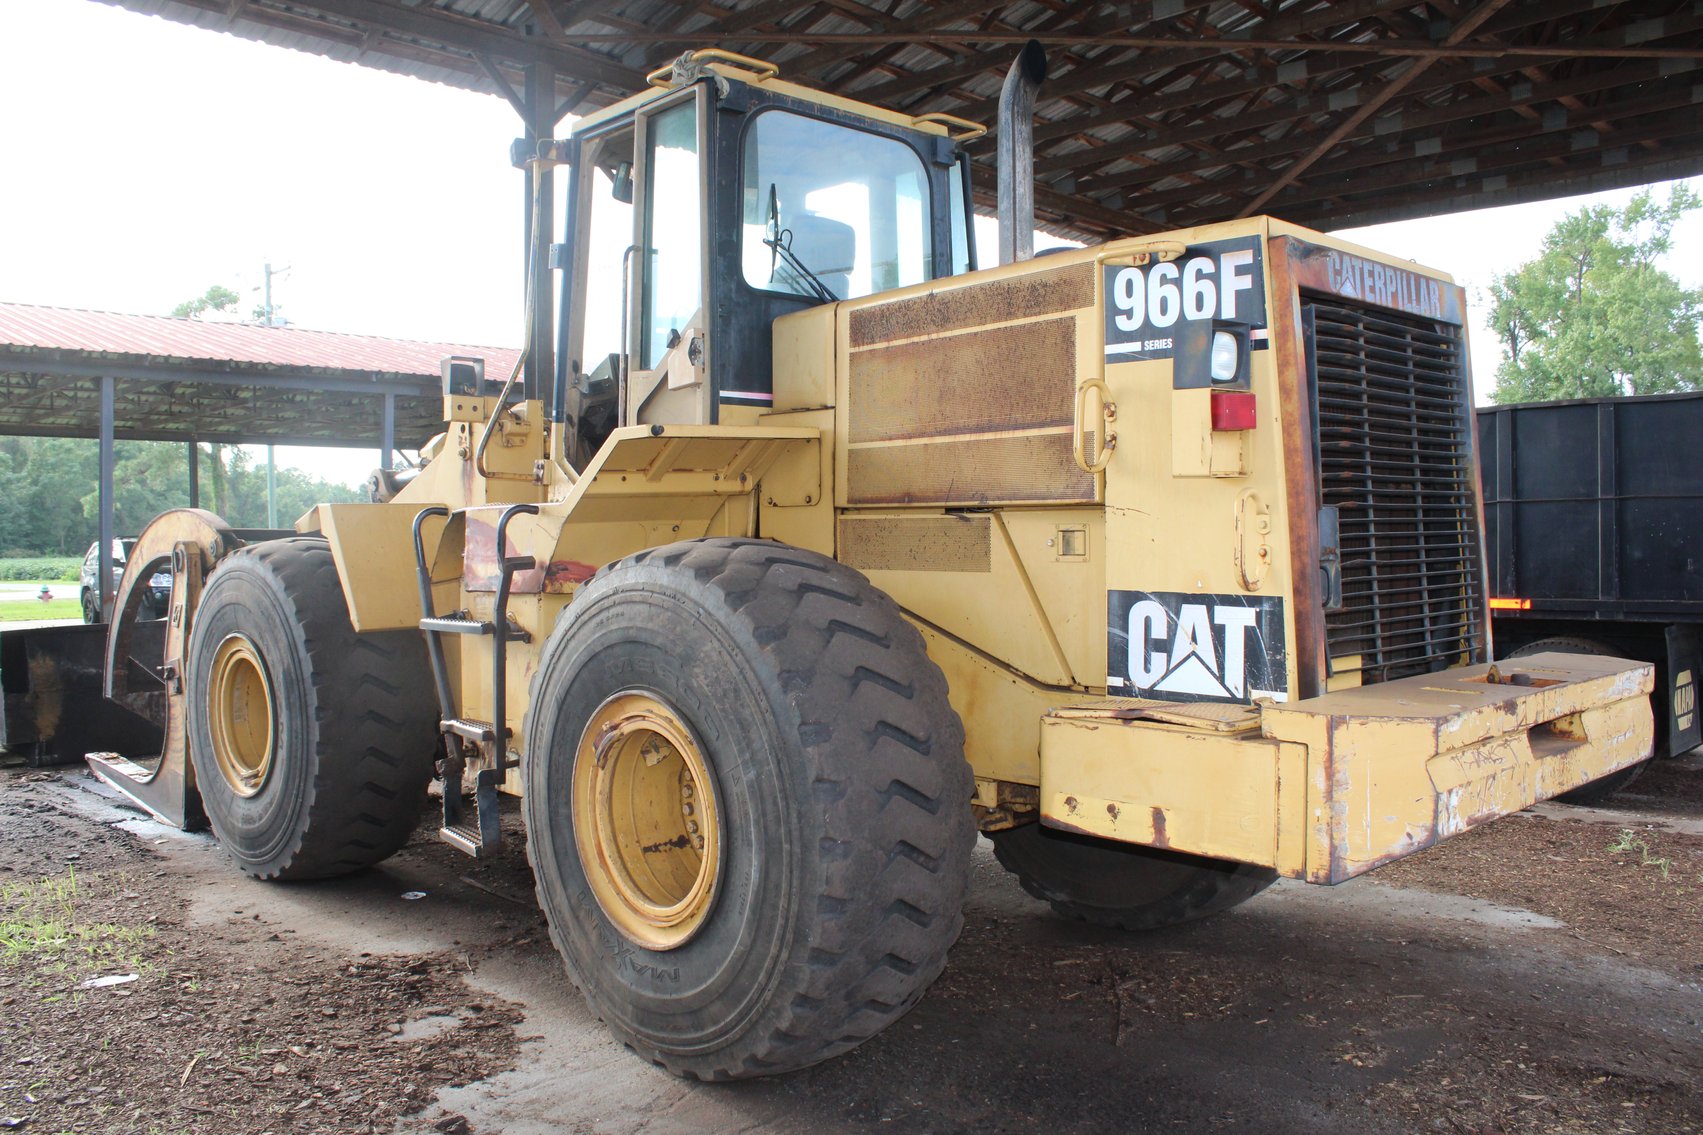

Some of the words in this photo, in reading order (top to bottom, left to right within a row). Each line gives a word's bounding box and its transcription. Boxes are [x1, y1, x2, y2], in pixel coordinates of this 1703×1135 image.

[1113, 250, 1253, 332] 966F
[1327, 250, 1441, 318] CATERPILLAR
[1144, 338, 1173, 351] SERIES
[1128, 600, 1256, 699] CAT
